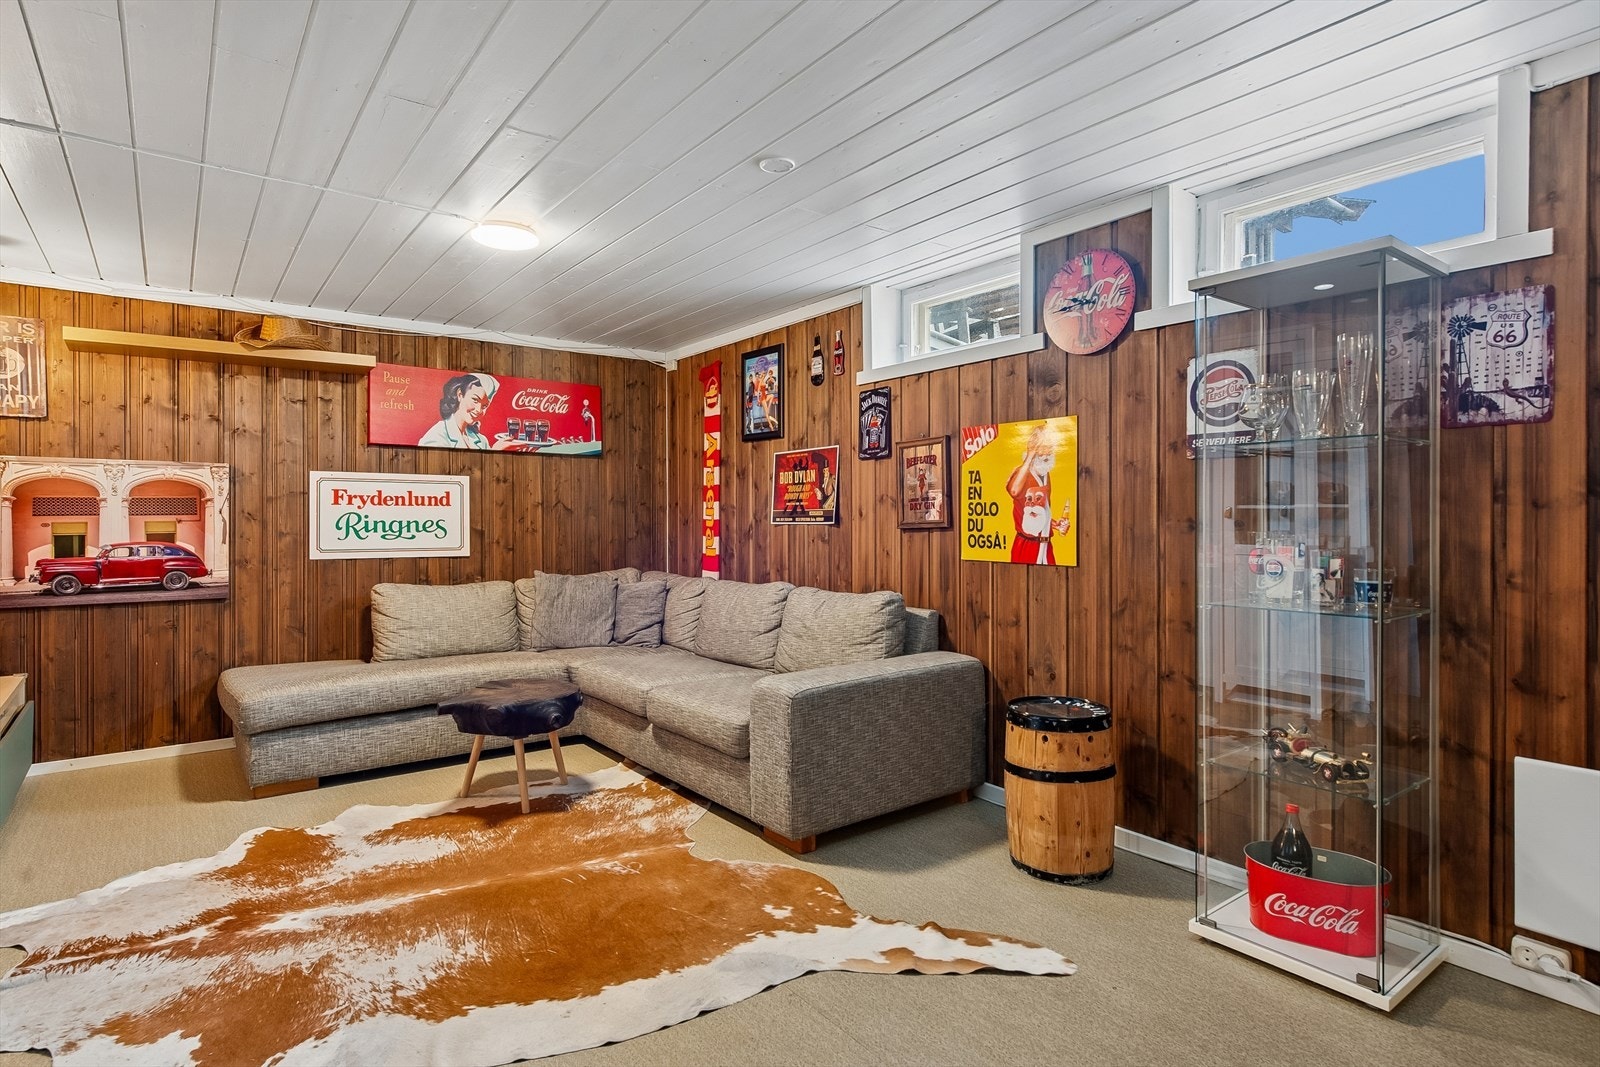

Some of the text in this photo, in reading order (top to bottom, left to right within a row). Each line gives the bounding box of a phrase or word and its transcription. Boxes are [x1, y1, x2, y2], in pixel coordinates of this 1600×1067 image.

[17, 322, 35, 335] IS
[1493, 330, 1517, 343] 66
[383, 371, 411, 385] Pause
[386, 386, 407, 396] and
[526, 387, 549, 395] DRINK
[0, 394, 39, 409] APY
[380, 398, 415, 411] refresh
[512, 390, 571, 414] Coca-Cola
[964, 427, 995, 459] Solo
[1192, 435, 1252, 448] SERVED HERE
[906, 454, 938, 469] BEEFEATER
[779, 469, 816, 485] BOB DYLAN
[968, 470, 982, 485] TA
[331, 488, 451, 510] Frydenlund
[705, 432, 718, 557] Arsenal
[968, 486, 983, 500] EN
[909, 500, 936, 511] DRY GIN
[967, 501, 999, 517] SOLO
[335, 511, 448, 541] Ringnes
[967, 518, 984, 532] DU
[1264, 892, 1365, 935] Coca-Cola
